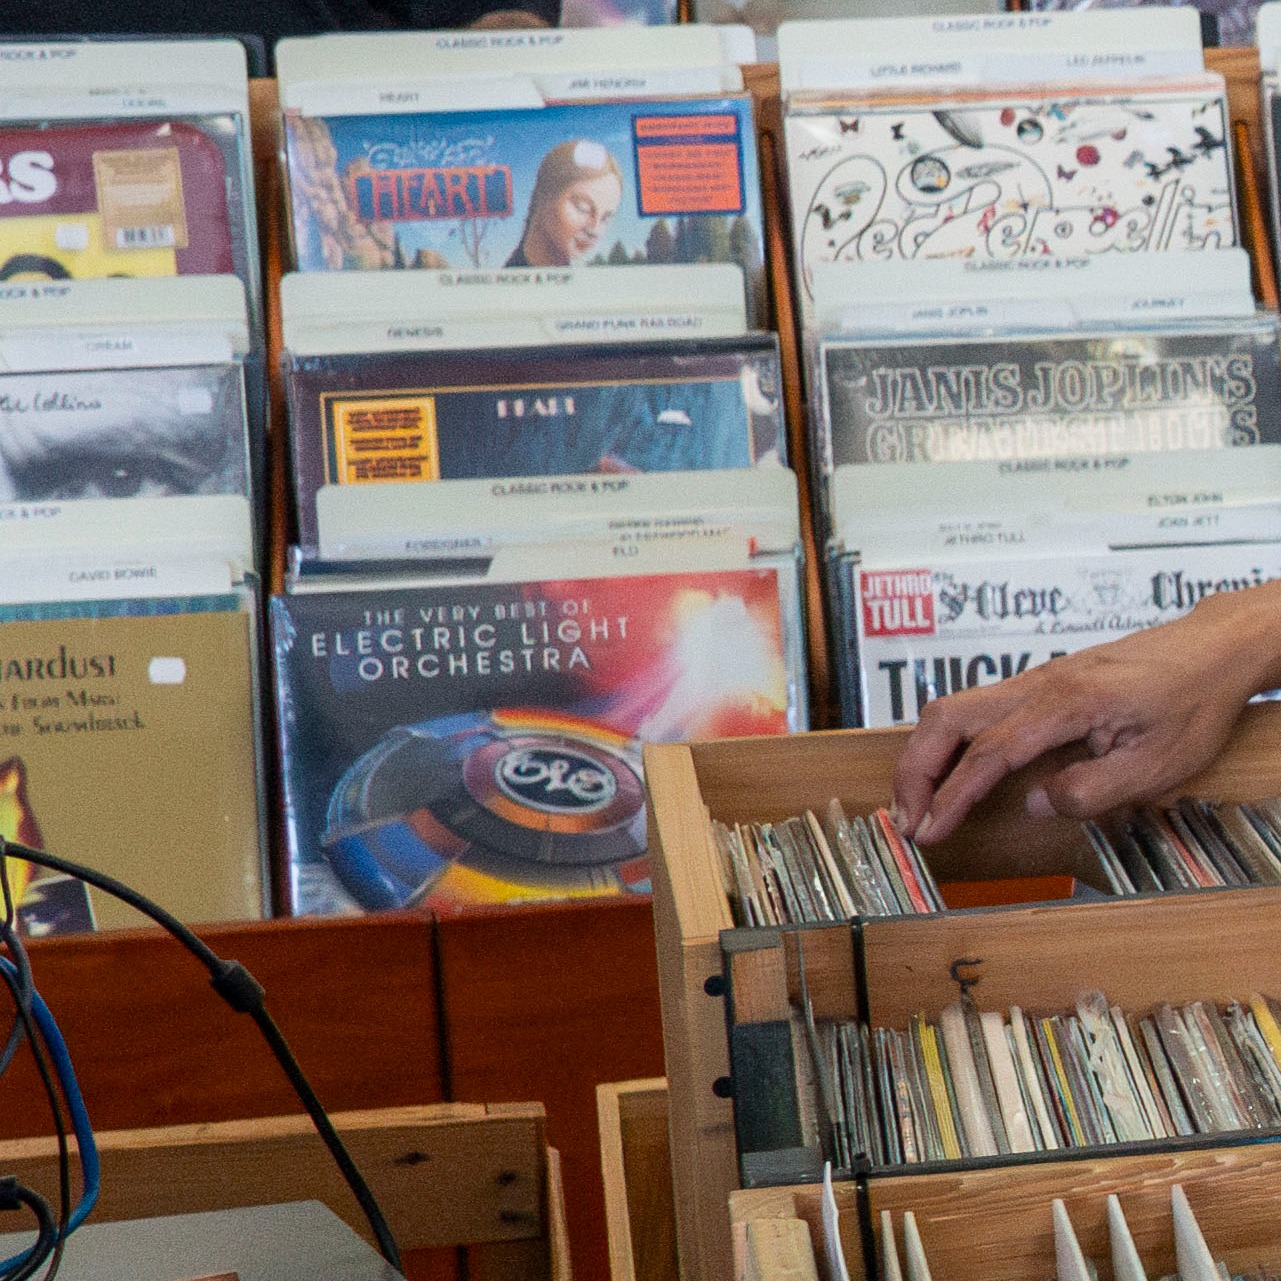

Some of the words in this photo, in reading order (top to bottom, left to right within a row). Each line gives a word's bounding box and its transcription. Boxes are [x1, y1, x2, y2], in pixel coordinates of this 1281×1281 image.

[866, 360, 1026, 421] JANIS
[491, 482, 547, 498] CLASSIC
[549, 481, 587, 495] ROCK
[602, 479, 630, 493] POP
[862, 573, 932, 600] JETHRO
[363, 608, 405, 628] THE
[417, 604, 482, 625] VERY
[494, 600, 552, 622] BEST
[866, 598, 931, 631] TULL
[311, 623, 498, 658] ELECTRIC
[519, 616, 631, 645] LIGHT
[356, 647, 592, 683] ORCHESTRA
